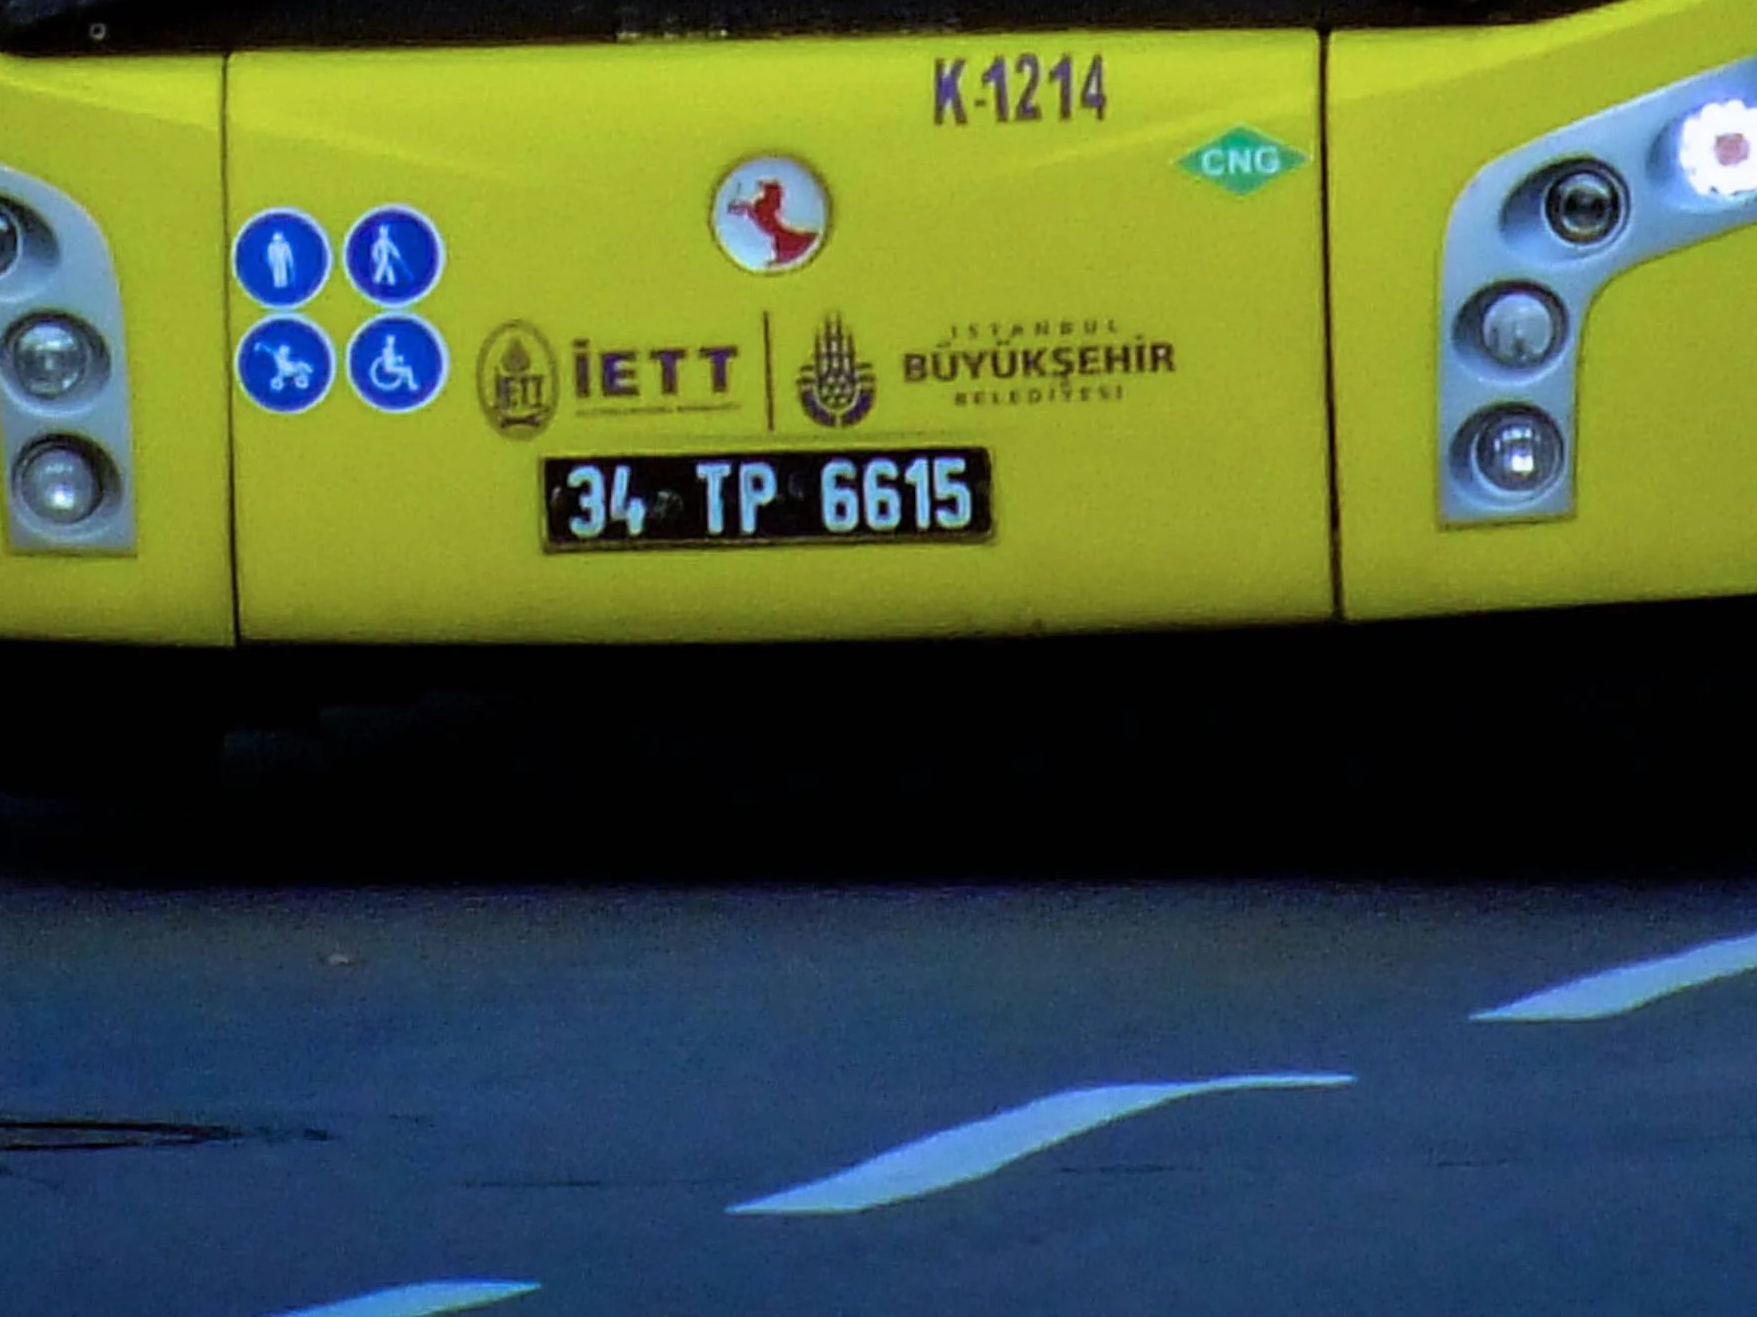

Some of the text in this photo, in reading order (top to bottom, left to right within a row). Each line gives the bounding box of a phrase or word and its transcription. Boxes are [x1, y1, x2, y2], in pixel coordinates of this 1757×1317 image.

[933, 53, 1107, 125] K-1214
[1201, 147, 1281, 176] CNG
[903, 334, 1175, 389] BÜYÜKŞEHİR
[566, 456, 971, 538] 34 TP 6615
